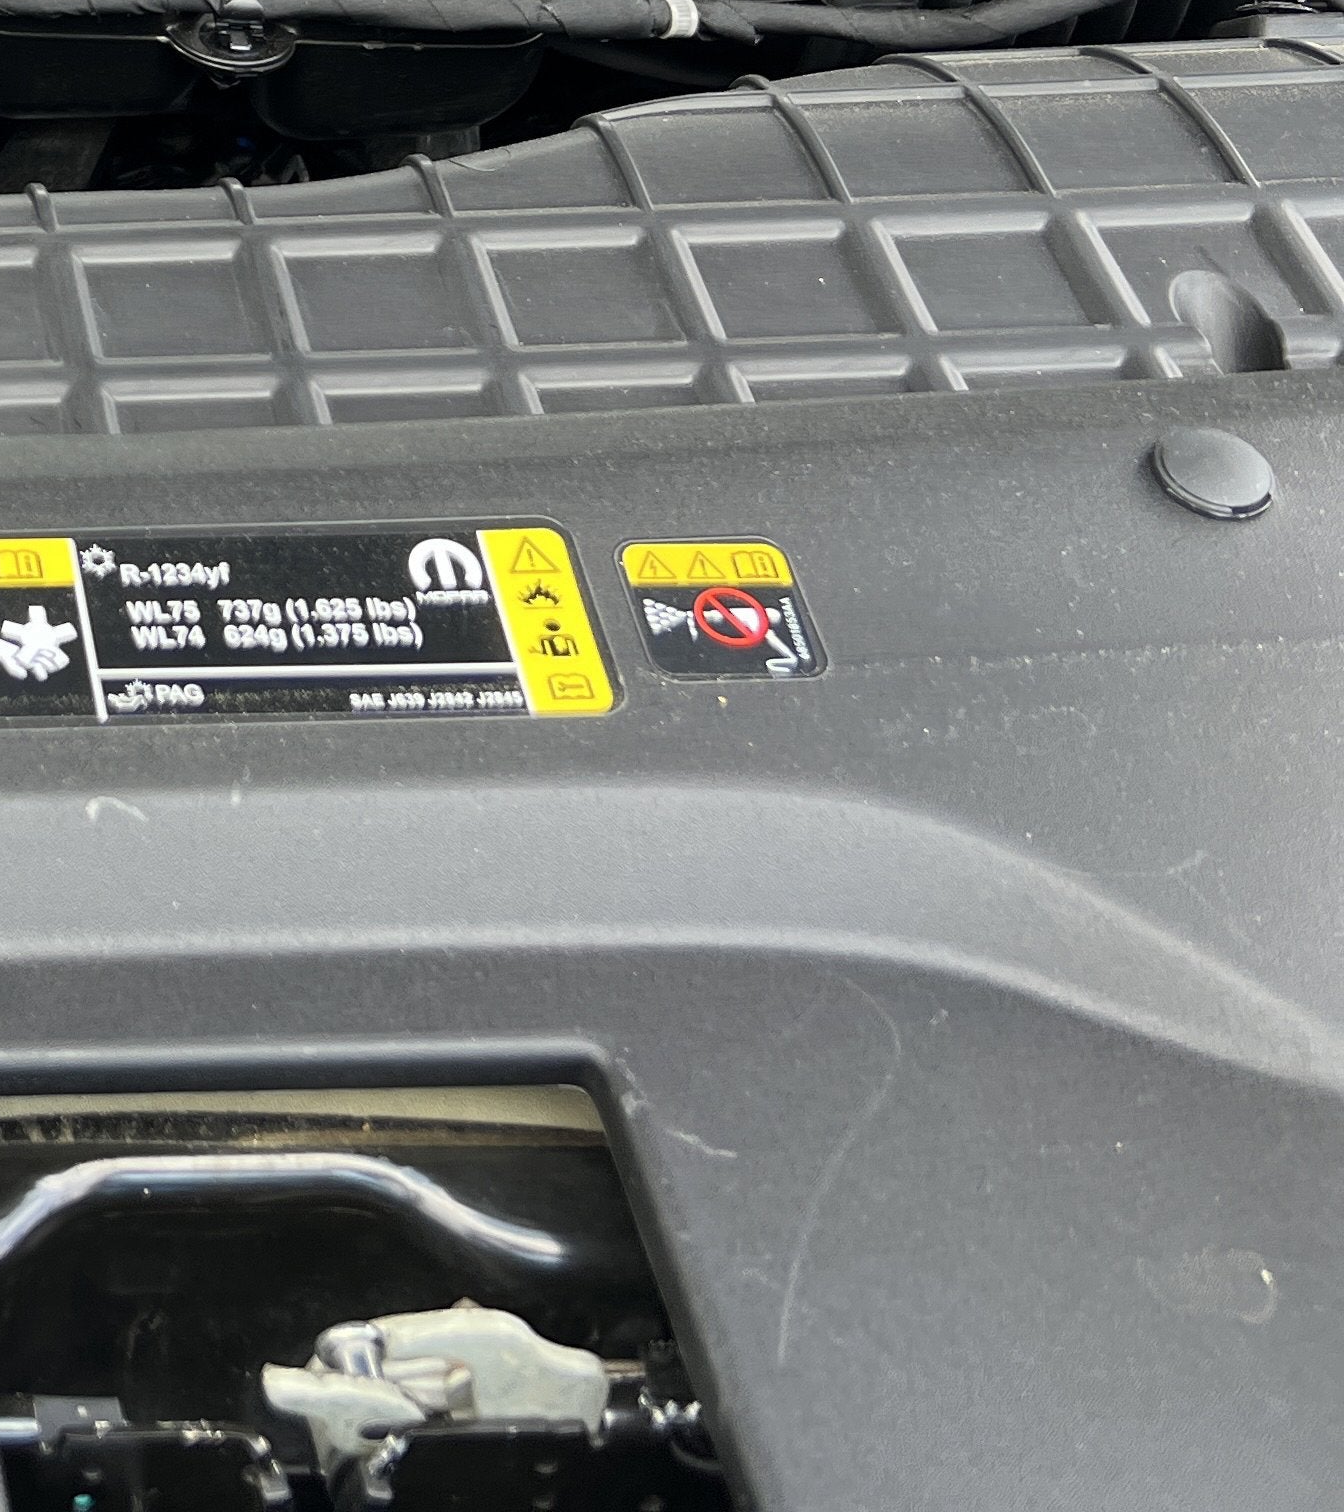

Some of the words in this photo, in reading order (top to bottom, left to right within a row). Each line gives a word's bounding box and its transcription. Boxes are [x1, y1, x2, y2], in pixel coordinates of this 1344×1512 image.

[119, 562, 231, 589] R-1234yf
[125, 600, 201, 624] WL75
[216, 598, 281, 625] 737g
[286, 597, 363, 624] (1.625
[366, 596, 417, 623] lbs)
[130, 624, 206, 651] WL74
[223, 624, 289, 653] 624g
[291, 623, 370, 652] (1.375
[373, 622, 424, 651] lbs)
[155, 683, 205, 707] PAG
[349, 692, 385, 710] SAE
